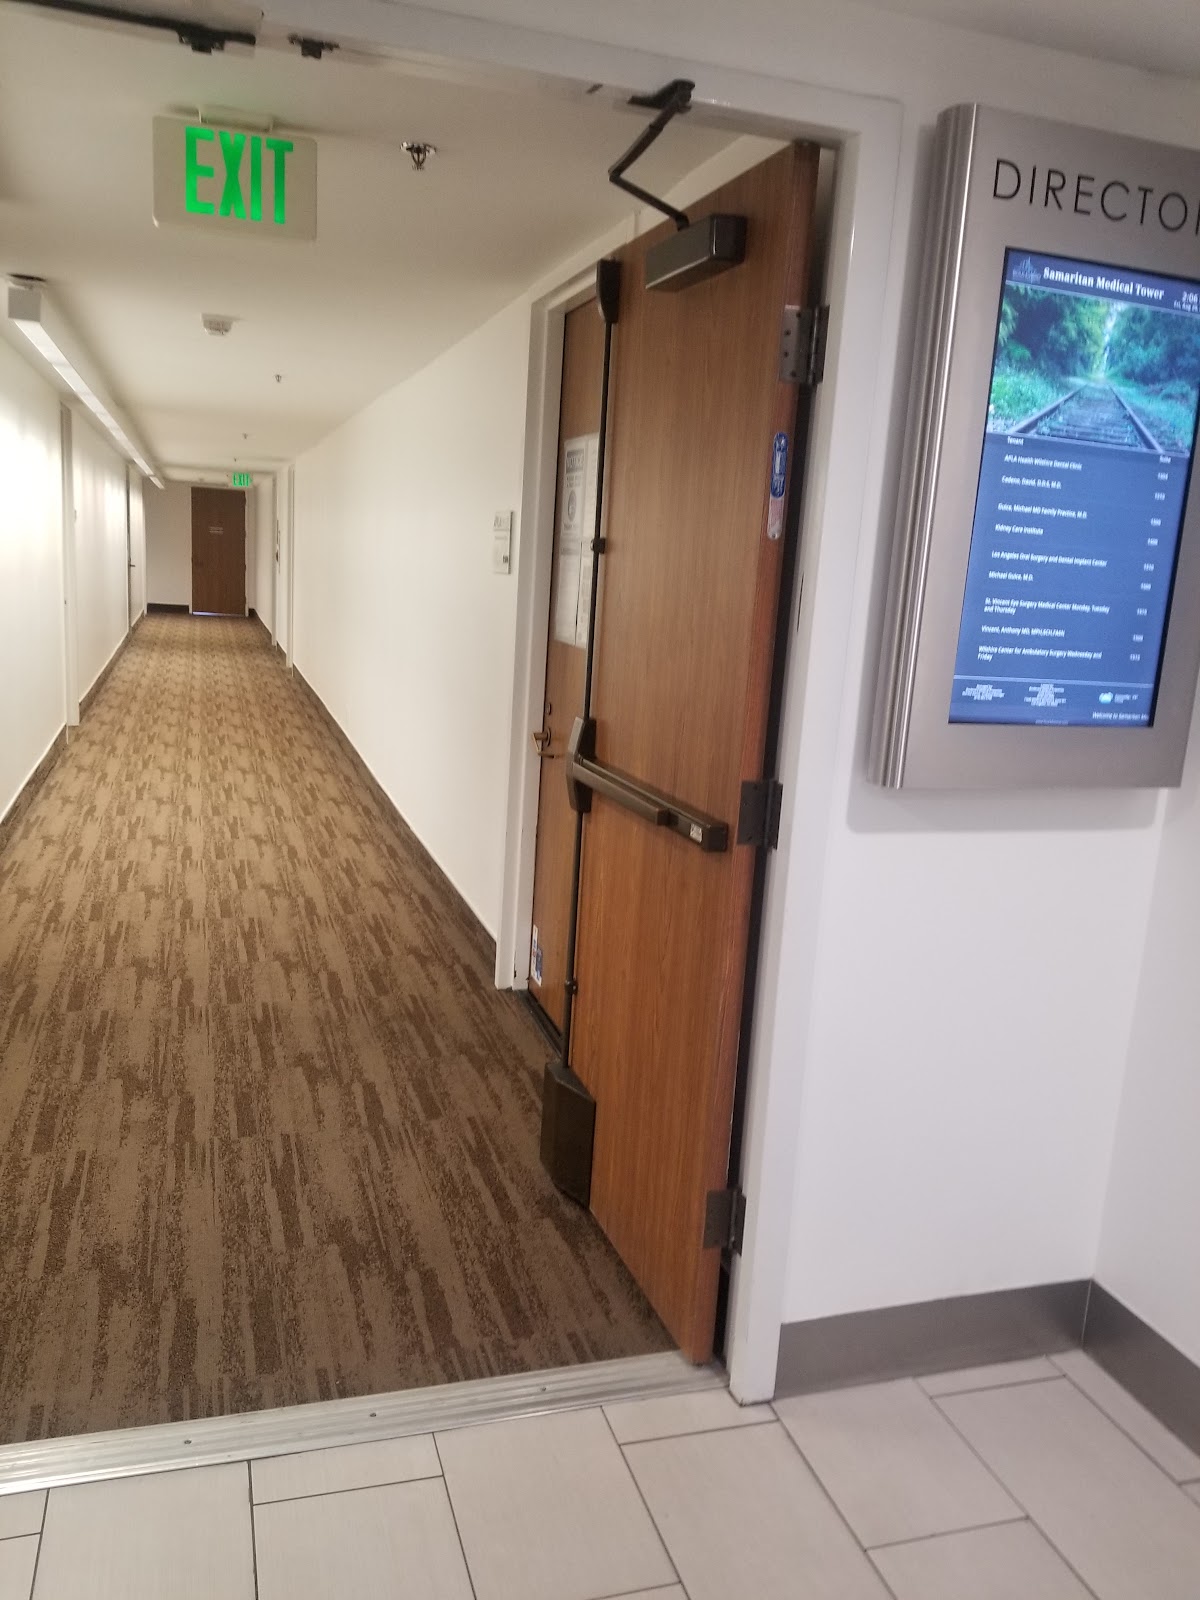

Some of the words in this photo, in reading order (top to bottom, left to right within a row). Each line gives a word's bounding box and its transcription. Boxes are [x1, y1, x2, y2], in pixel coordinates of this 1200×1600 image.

[185, 125, 294, 225] EXIT
[993, 157, 1200, 235] DIRECTO
[1043, 266, 1095, 288] Samaritan
[1096, 275, 1134, 295] Medical
[1135, 283, 1165, 300] Tower
[232, 472, 249, 487] EXIT
[995, 523, 1012, 534] Kidney
[991, 550, 1001, 559] Los
[1000, 551, 1020, 561] Angeles
[1030, 553, 1049, 564] Surgery
[994, 605, 1017, 616] Thursday
[1019, 599, 1038, 610] Surgery
[1000, 626, 1021, 636] Anthony
[977, 652, 993, 662] Friday
